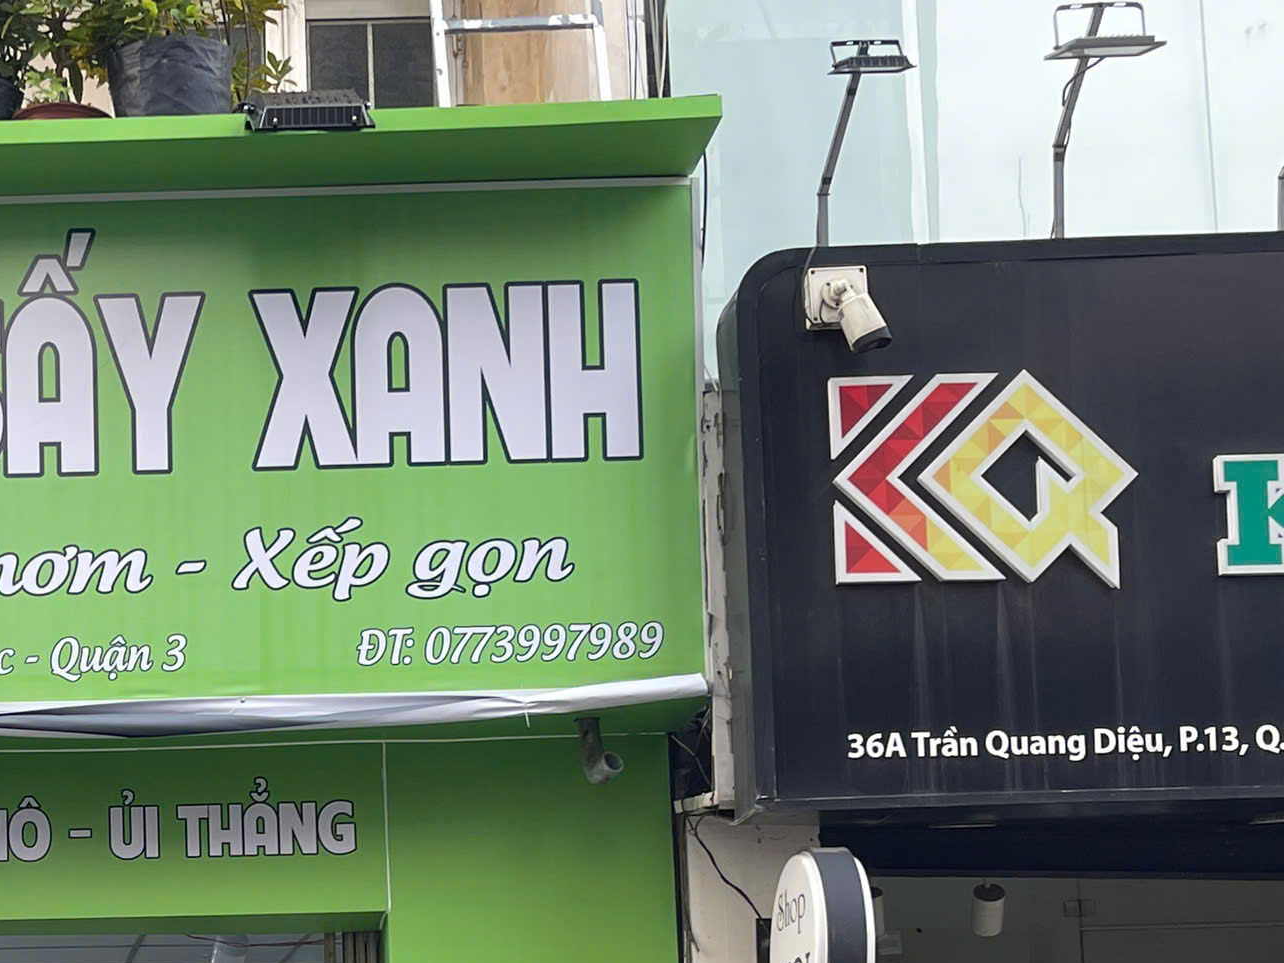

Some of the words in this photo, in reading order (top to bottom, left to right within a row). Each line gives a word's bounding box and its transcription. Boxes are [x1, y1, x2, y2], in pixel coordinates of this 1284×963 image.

[248, 278, 644, 471] XANH
[231, 516, 390, 602] Xếp
[405, 536, 575, 599] gọn
[50, 634, 154, 681] Quận
[161, 633, 188, 672] 3
[356, 627, 415, 667] ĐT:
[424, 620, 666, 667] 0773997989
[846, 731, 907, 760] 36A
[911, 724, 978, 758] Trần
[985, 729, 1087, 762] Quang
[1094, 727, 1172, 762] Diệu,
[1179, 726, 1249, 756] P.13,
[108, 789, 160, 860] ỦI
[176, 776, 357, 859] THẲNG
[776, 892, 806, 935] Shop
